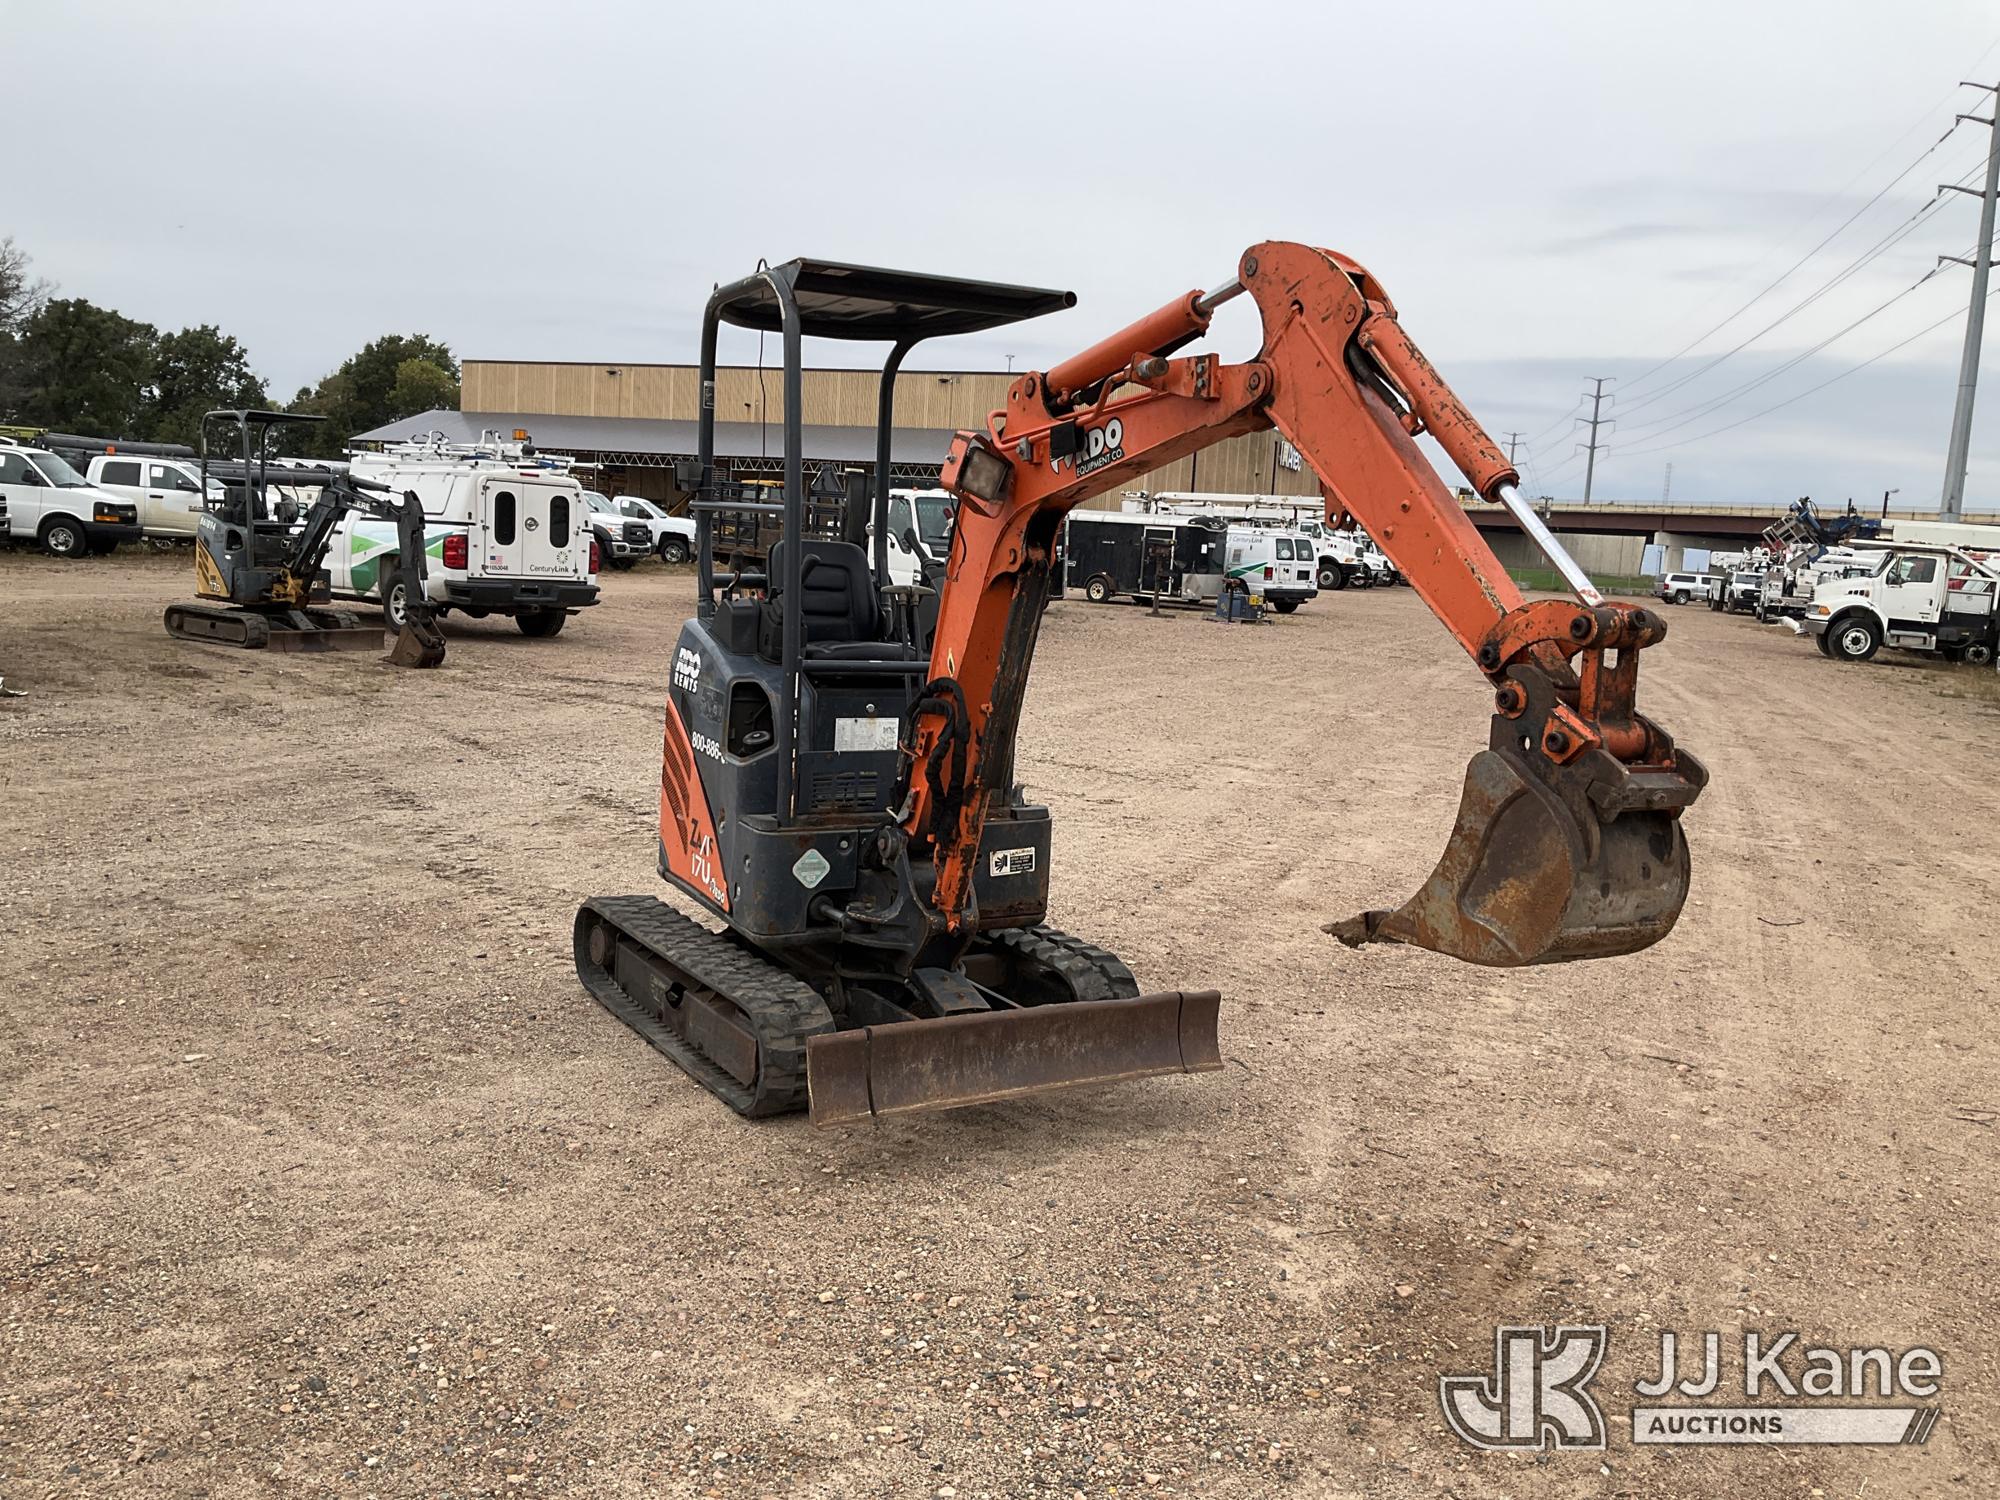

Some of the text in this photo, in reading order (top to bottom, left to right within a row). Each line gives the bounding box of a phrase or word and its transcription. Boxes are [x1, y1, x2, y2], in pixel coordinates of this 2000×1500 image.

[1077, 454, 1110, 476] EQUIPMENT
[530, 564, 569, 573] CenturyLink
[674, 671, 699, 693] RENTS
